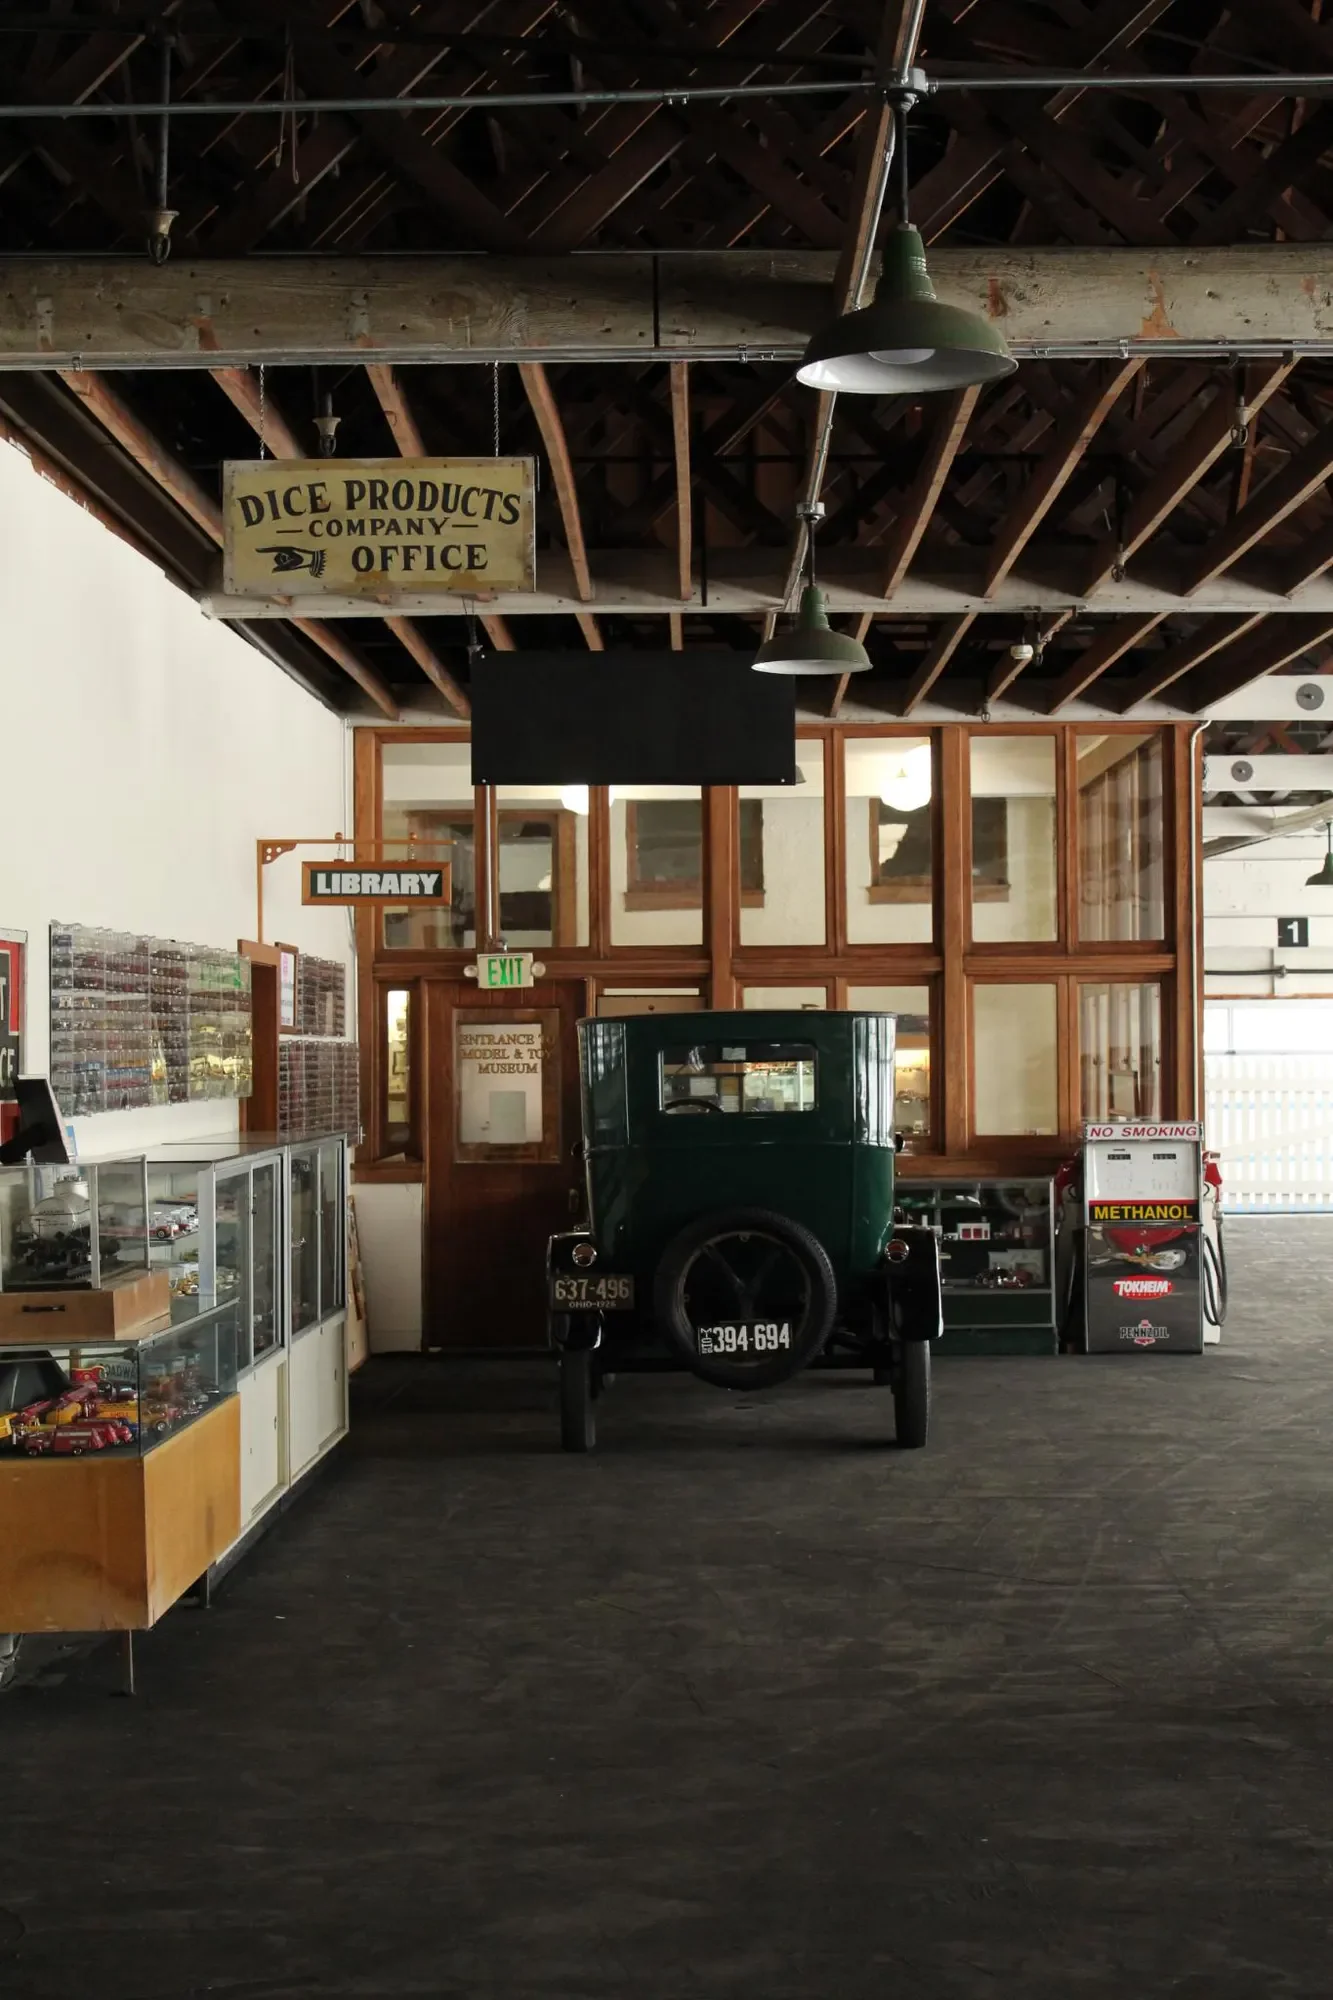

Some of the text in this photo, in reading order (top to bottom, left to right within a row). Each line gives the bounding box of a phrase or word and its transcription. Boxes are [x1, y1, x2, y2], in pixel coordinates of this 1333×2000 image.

[236, 478, 521, 528] DICE PRODUCTS
[308, 517, 450, 537] COMPANY
[351, 543, 488, 573] OFFICE
[316, 873, 439, 895] LIBRARY
[1287, 921, 1299, 943] 1
[487, 957, 524, 986] EXIT
[459, 1034, 535, 1046] ENTRANCE
[460, 1048, 510, 1060] MODEL
[513, 1048, 523, 1059] &
[477, 1063, 539, 1074] MUSEUM
[1090, 1126, 1197, 1137] NO SMOKING
[1094, 1205, 1193, 1219] METHANOL
[555, 1278, 629, 1300] 637-496
[1113, 1280, 1169, 1296] TOKHEIM
[713, 1322, 790, 1353] 394-694
[1120, 1326, 1170, 1339] PENNZOIL
